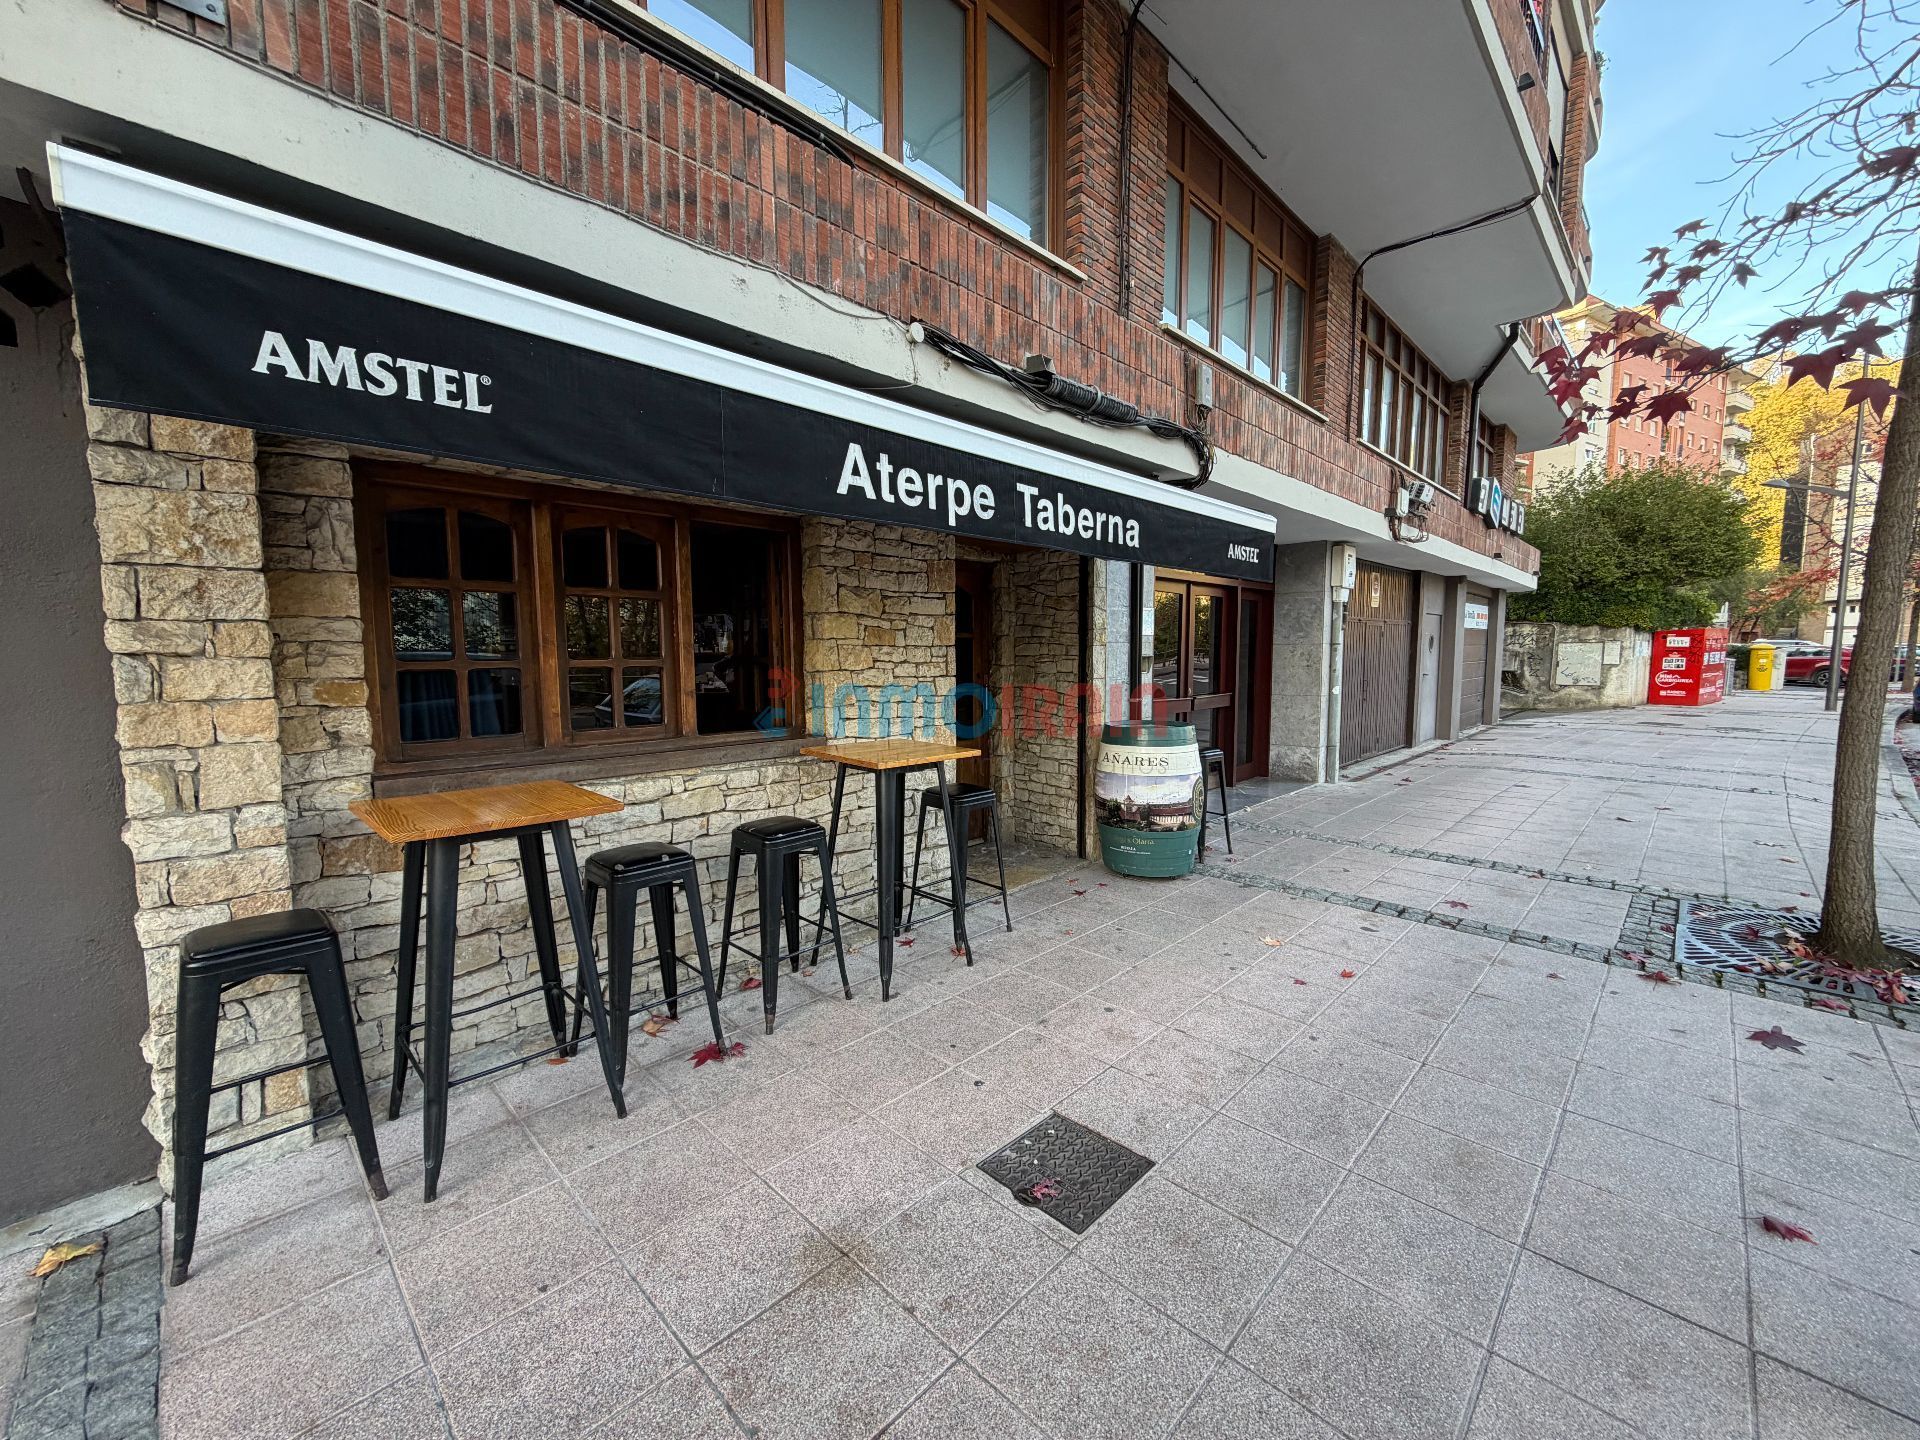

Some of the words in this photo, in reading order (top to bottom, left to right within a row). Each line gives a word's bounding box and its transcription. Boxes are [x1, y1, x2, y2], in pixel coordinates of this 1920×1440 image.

[837, 442, 996, 526] Aterpe
[1017, 483, 1140, 548] Taberna
[1102, 751, 1169, 767] AÑARES
